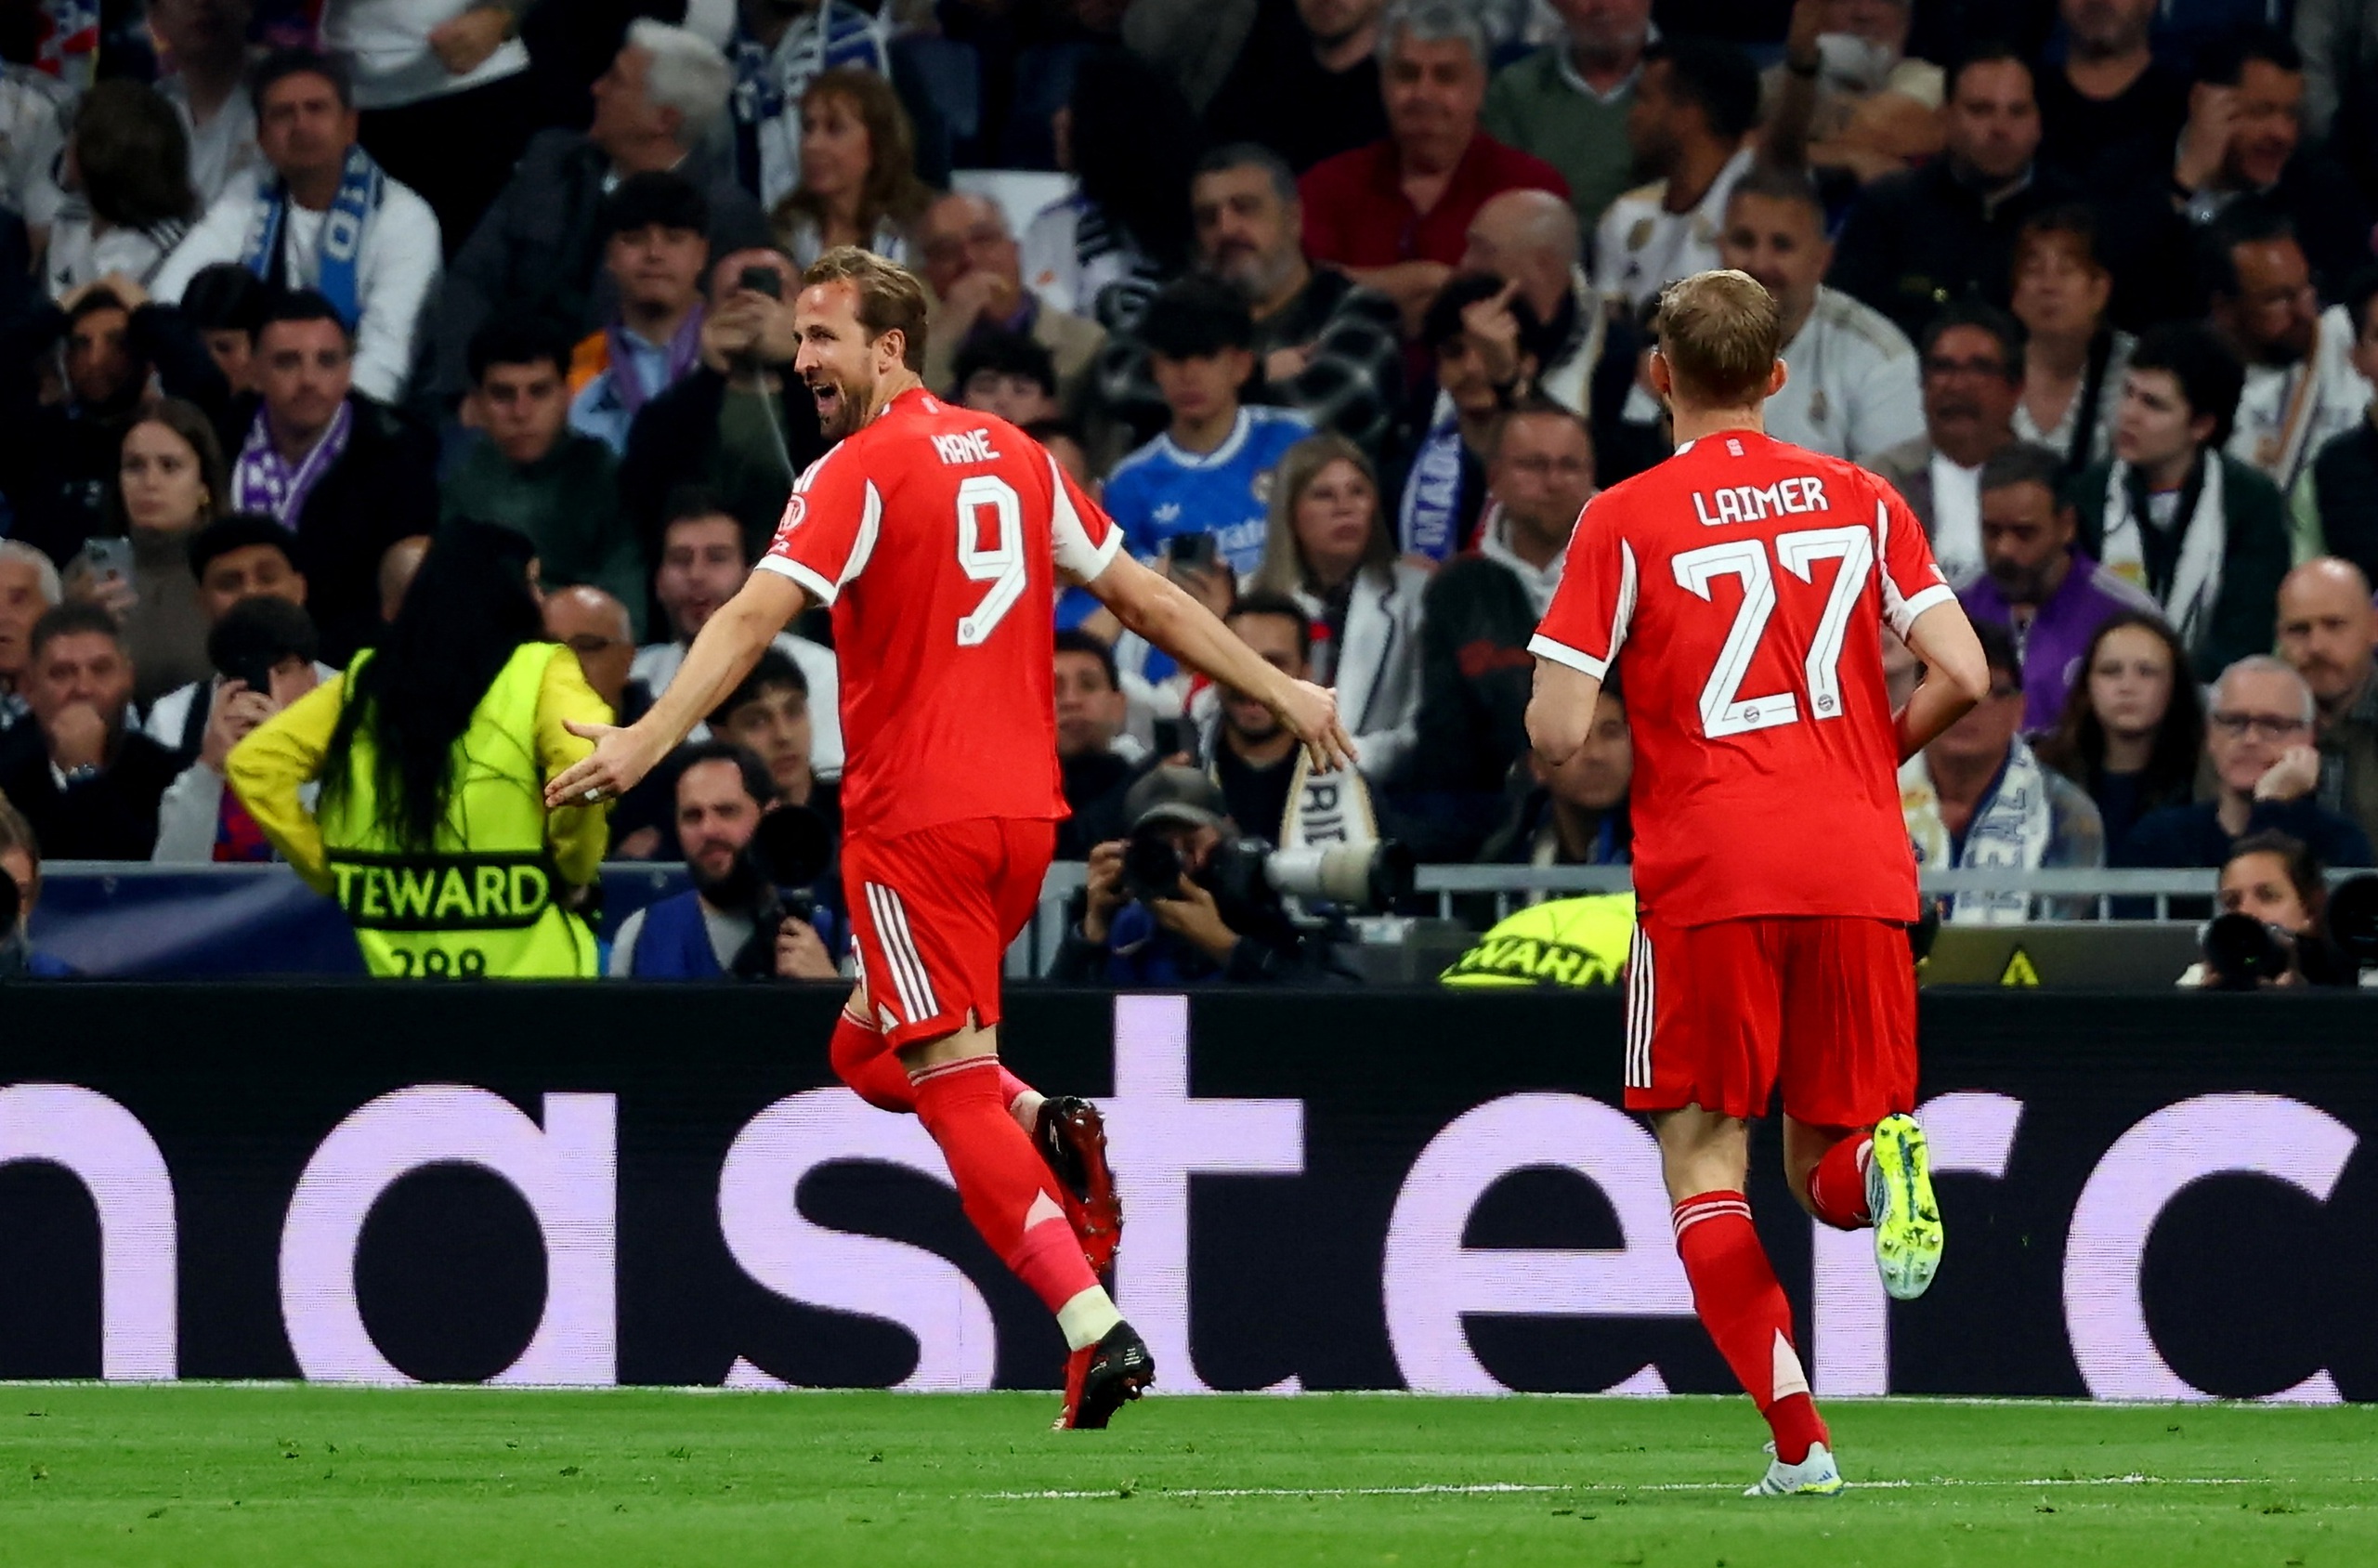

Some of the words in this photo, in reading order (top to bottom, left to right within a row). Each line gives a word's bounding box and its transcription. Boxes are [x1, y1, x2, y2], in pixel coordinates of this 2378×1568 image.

[930, 427, 1000, 464] KANE
[1692, 476, 1829, 527] LAIMER
[957, 475, 1027, 647] 9
[1671, 524, 1874, 738] 27
